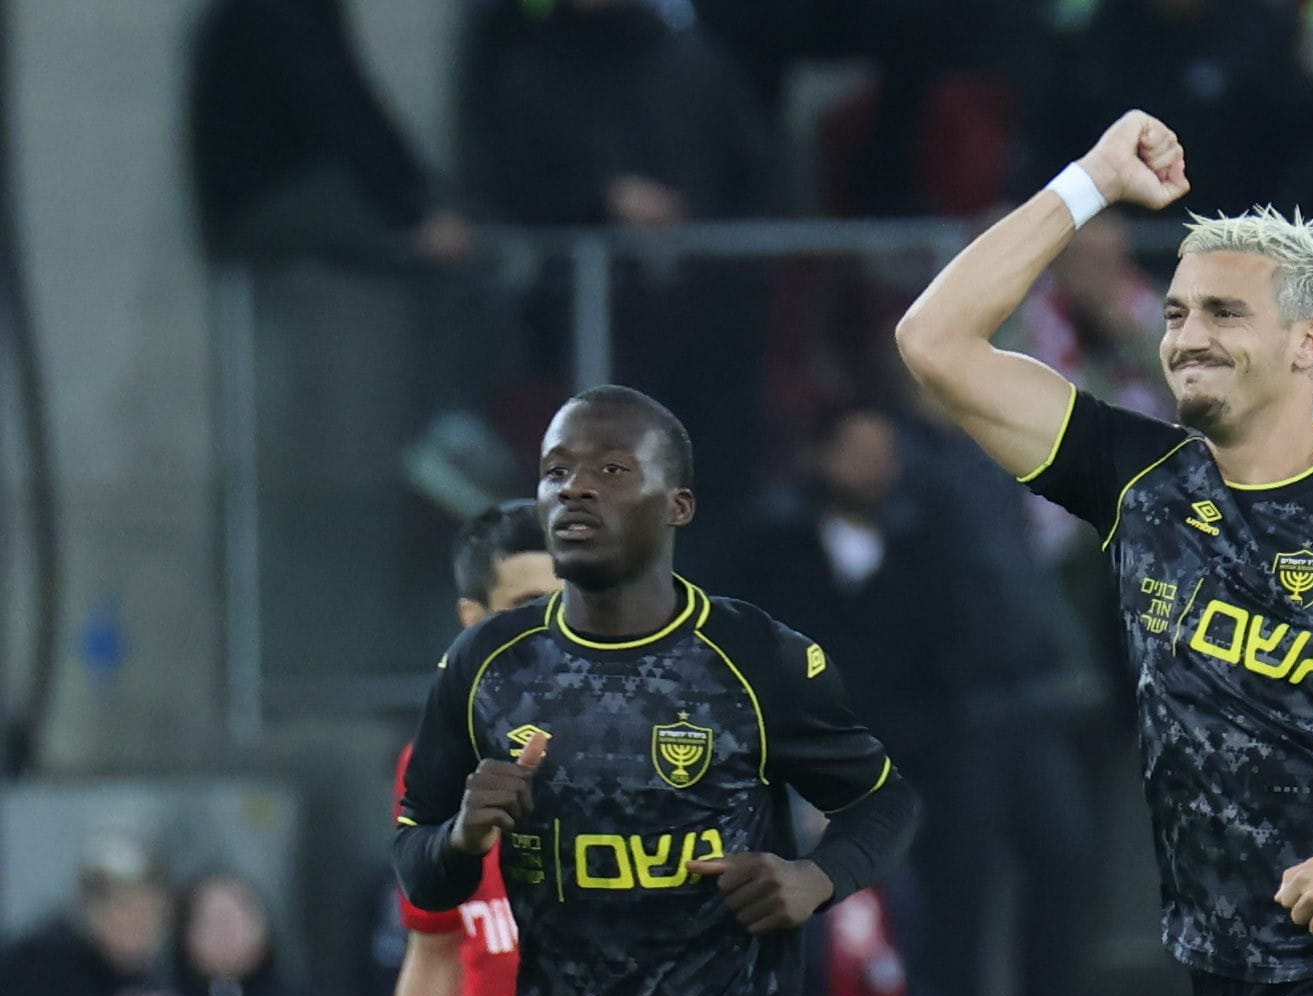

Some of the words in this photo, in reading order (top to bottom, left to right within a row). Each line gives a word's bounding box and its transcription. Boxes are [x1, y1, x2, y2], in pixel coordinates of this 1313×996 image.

[1185, 516, 1220, 537] umbro
[1141, 577, 1178, 600] בונים
[1148, 598, 1172, 618] את
[1141, 614, 1169, 634] ישר
